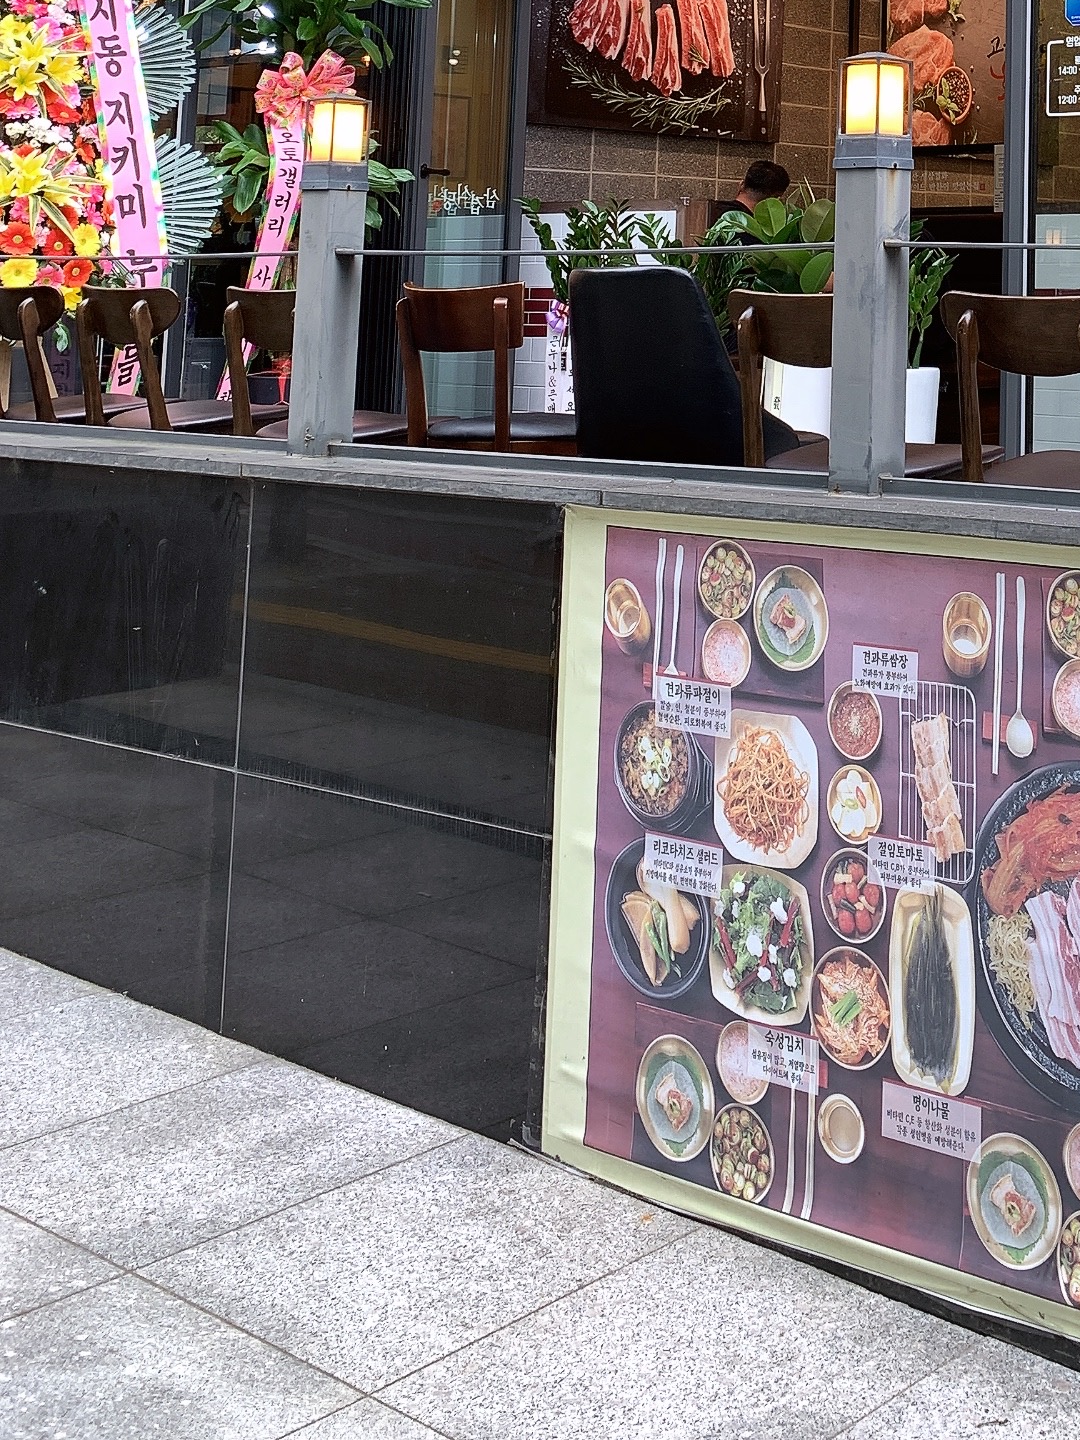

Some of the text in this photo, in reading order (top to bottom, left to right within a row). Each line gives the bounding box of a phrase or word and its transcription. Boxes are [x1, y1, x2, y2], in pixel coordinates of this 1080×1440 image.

[1058, 65, 1077, 75] 14:00
[1058, 95, 1077, 105] 12:00
[104, 91, 147, 229] 지키미
[267, 132, 301, 238] 오토갤러리
[863, 650, 908, 669] 견과류쌈장
[665, 681, 721, 705] 견과류파절이
[653, 839, 694, 860] 리코타치즈
[878, 841, 924, 862] 절임토마토
[765, 1029, 804, 1055] 숙성김치
[913, 1094, 950, 1121] 명이나물
